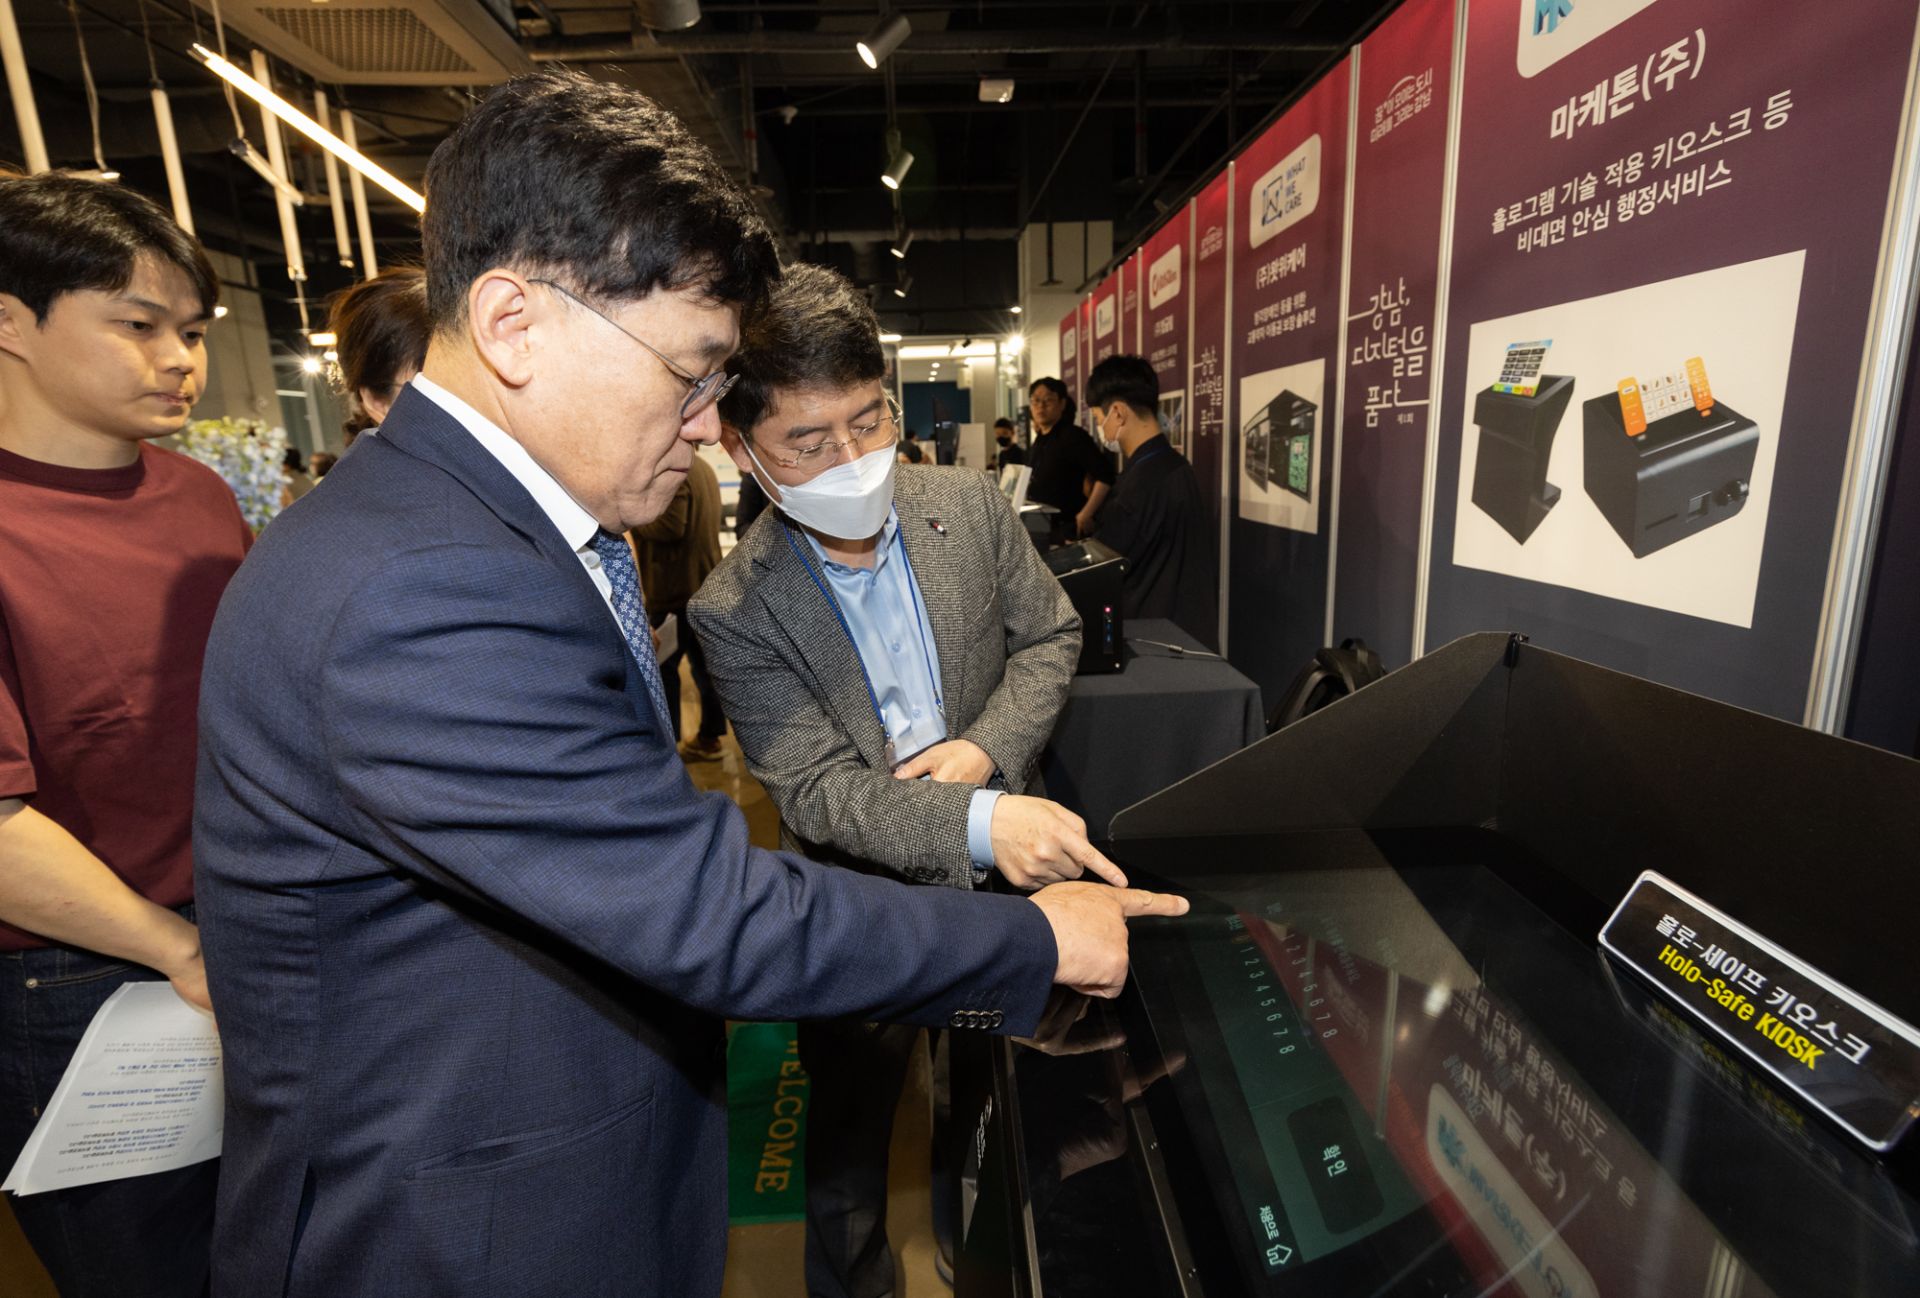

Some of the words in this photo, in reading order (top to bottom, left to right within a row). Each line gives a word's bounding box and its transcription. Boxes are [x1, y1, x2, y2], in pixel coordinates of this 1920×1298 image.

[1416, 67, 1432, 94] 도시
[1550, 27, 1706, 139] 마케톤(주)
[1286, 156, 1306, 181] WHAT
[1492, 186, 1555, 235] 홀로그램
[1560, 170, 1598, 204] 기술
[1604, 151, 1645, 189] 적용
[1651, 108, 1752, 170] 키오스크
[1762, 89, 1794, 131] 등
[1285, 181, 1296, 196] WE
[1285, 193, 1303, 213] CARE
[1517, 216, 1565, 253] 비대면
[1571, 200, 1610, 238] 안심
[1616, 159, 1732, 224] 행정서비스
[1351, 326, 1428, 377] 디지털을
[1365, 380, 1425, 428] 품다
[1655, 914, 1768, 995] 홀로-세이프
[1766, 986, 1872, 1065] 키오스크
[1657, 944, 1756, 1022] Holo-Safe
[1754, 1013, 1825, 1070] KIOSK
[1323, 1144, 1348, 1177] 확인
[1259, 1205, 1279, 1241] 처음으로
